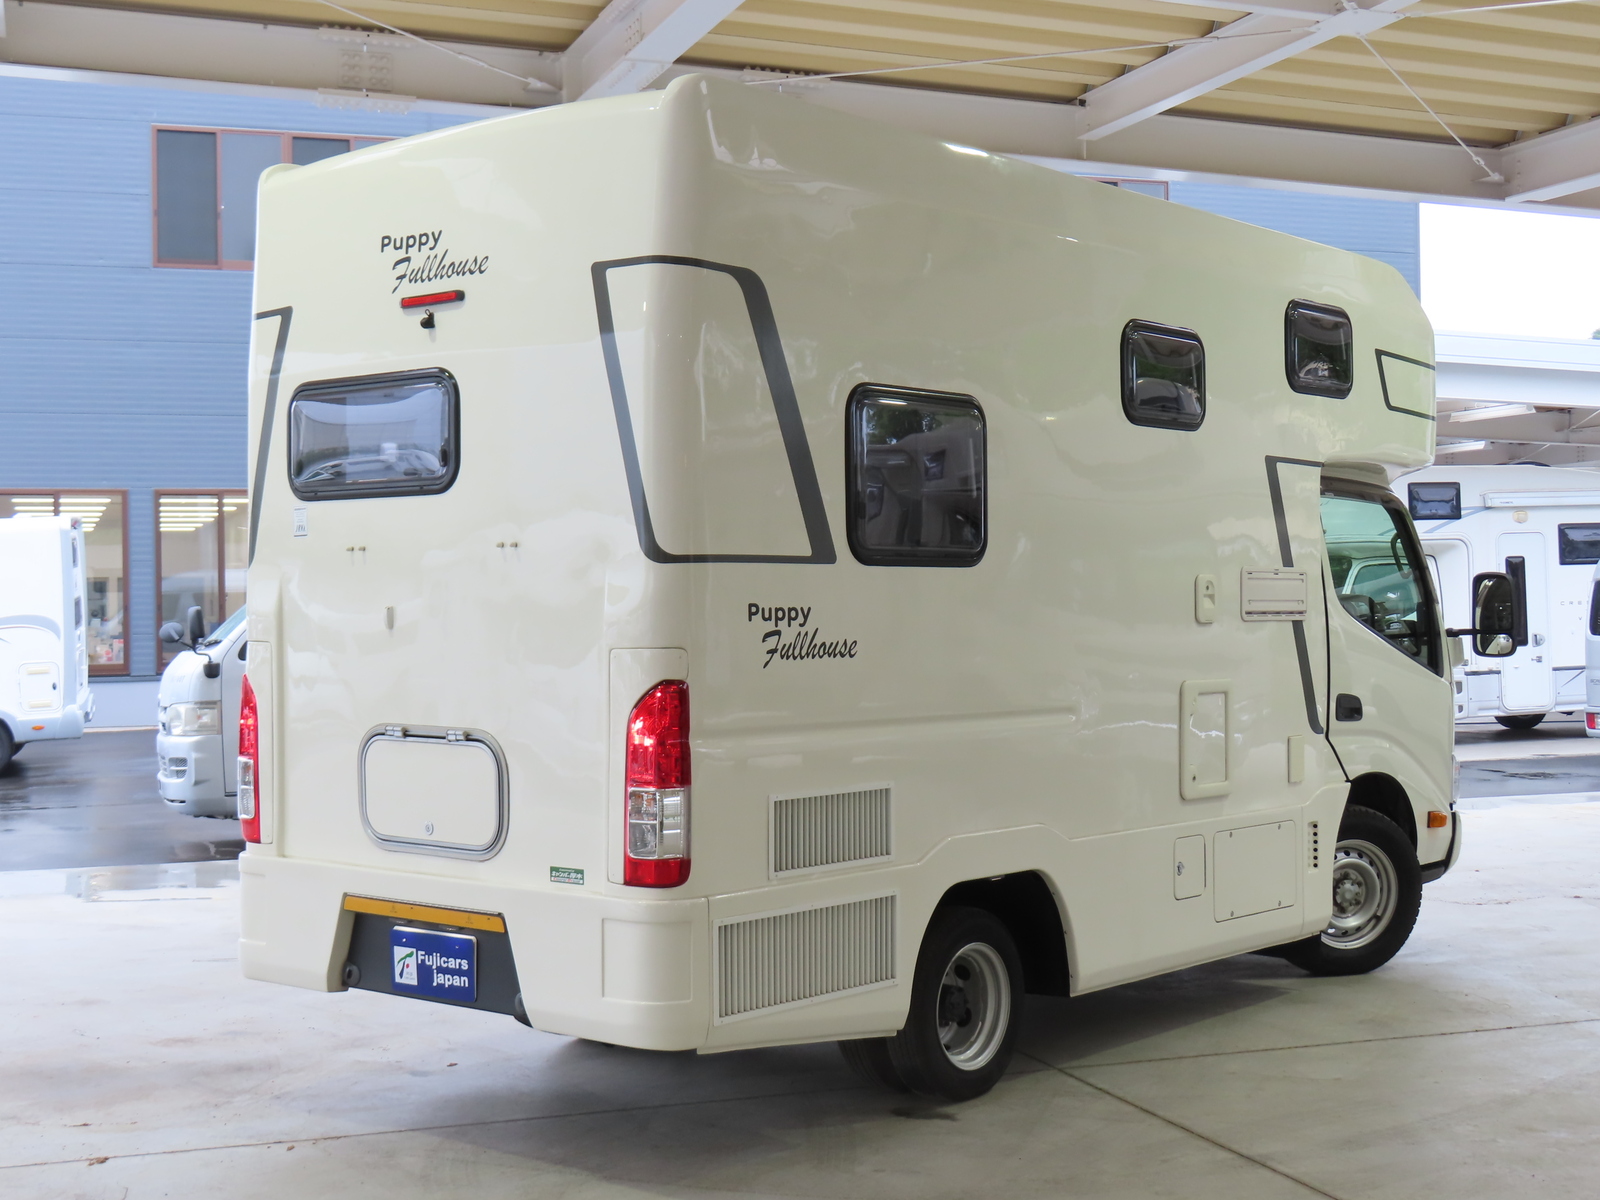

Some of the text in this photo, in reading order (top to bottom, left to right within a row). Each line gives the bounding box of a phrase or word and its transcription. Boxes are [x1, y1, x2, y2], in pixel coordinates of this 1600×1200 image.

[380, 229, 443, 255] Puppy
[391, 248, 490, 294] Fullhouse
[747, 602, 812, 628] Puppy
[761, 627, 858, 669] Fullhouse
[417, 950, 469, 970] Fujicars
[432, 969, 469, 988] japan
